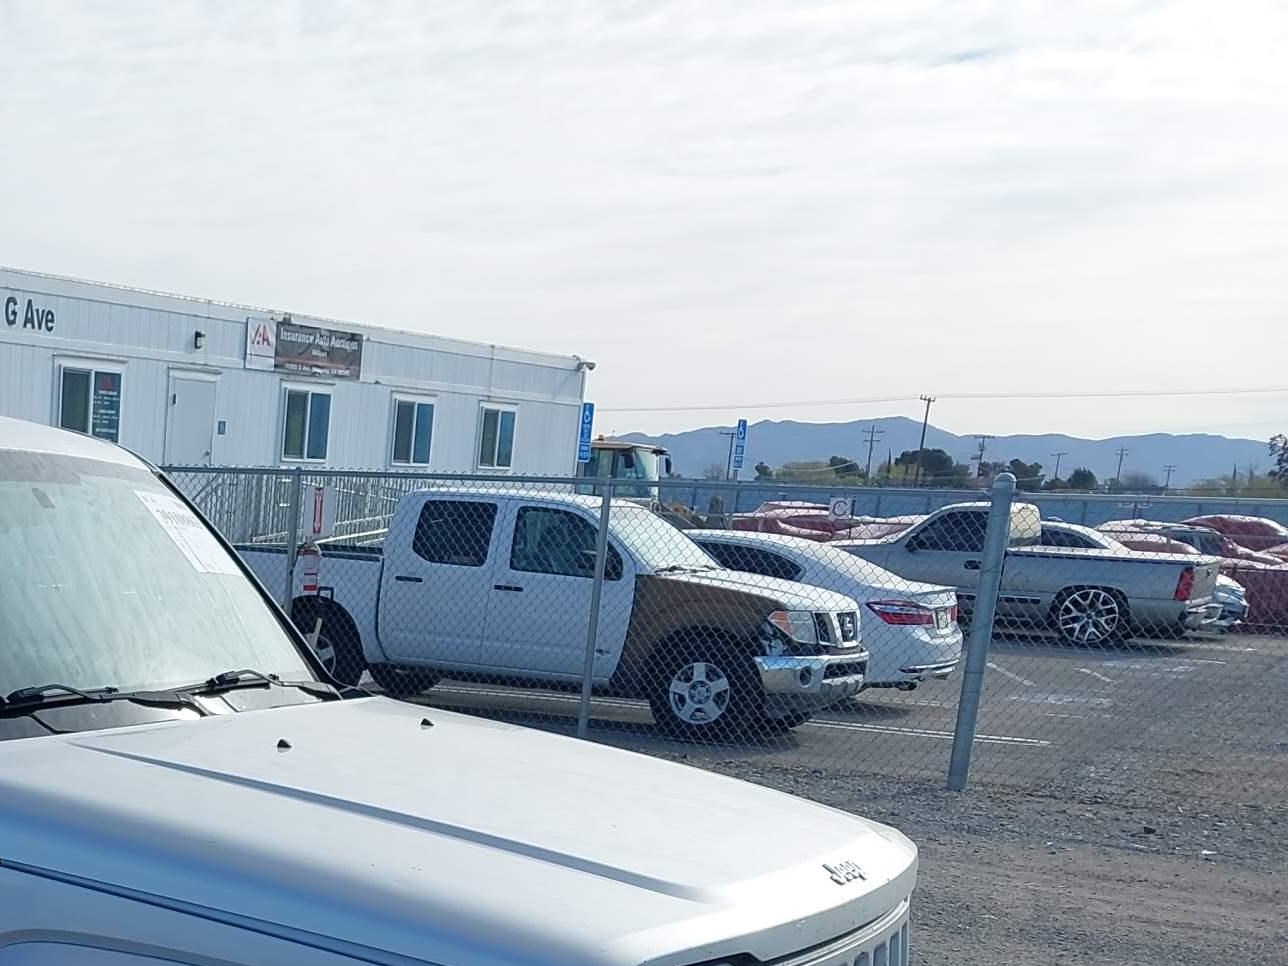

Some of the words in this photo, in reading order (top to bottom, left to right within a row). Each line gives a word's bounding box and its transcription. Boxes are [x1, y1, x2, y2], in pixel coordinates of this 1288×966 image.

[5, 296, 18, 326] G
[23, 299, 55, 332] Ave
[280, 327, 315, 345] Insurance
[314, 332, 330, 347] Auto
[821, 860, 867, 886] Jeep
